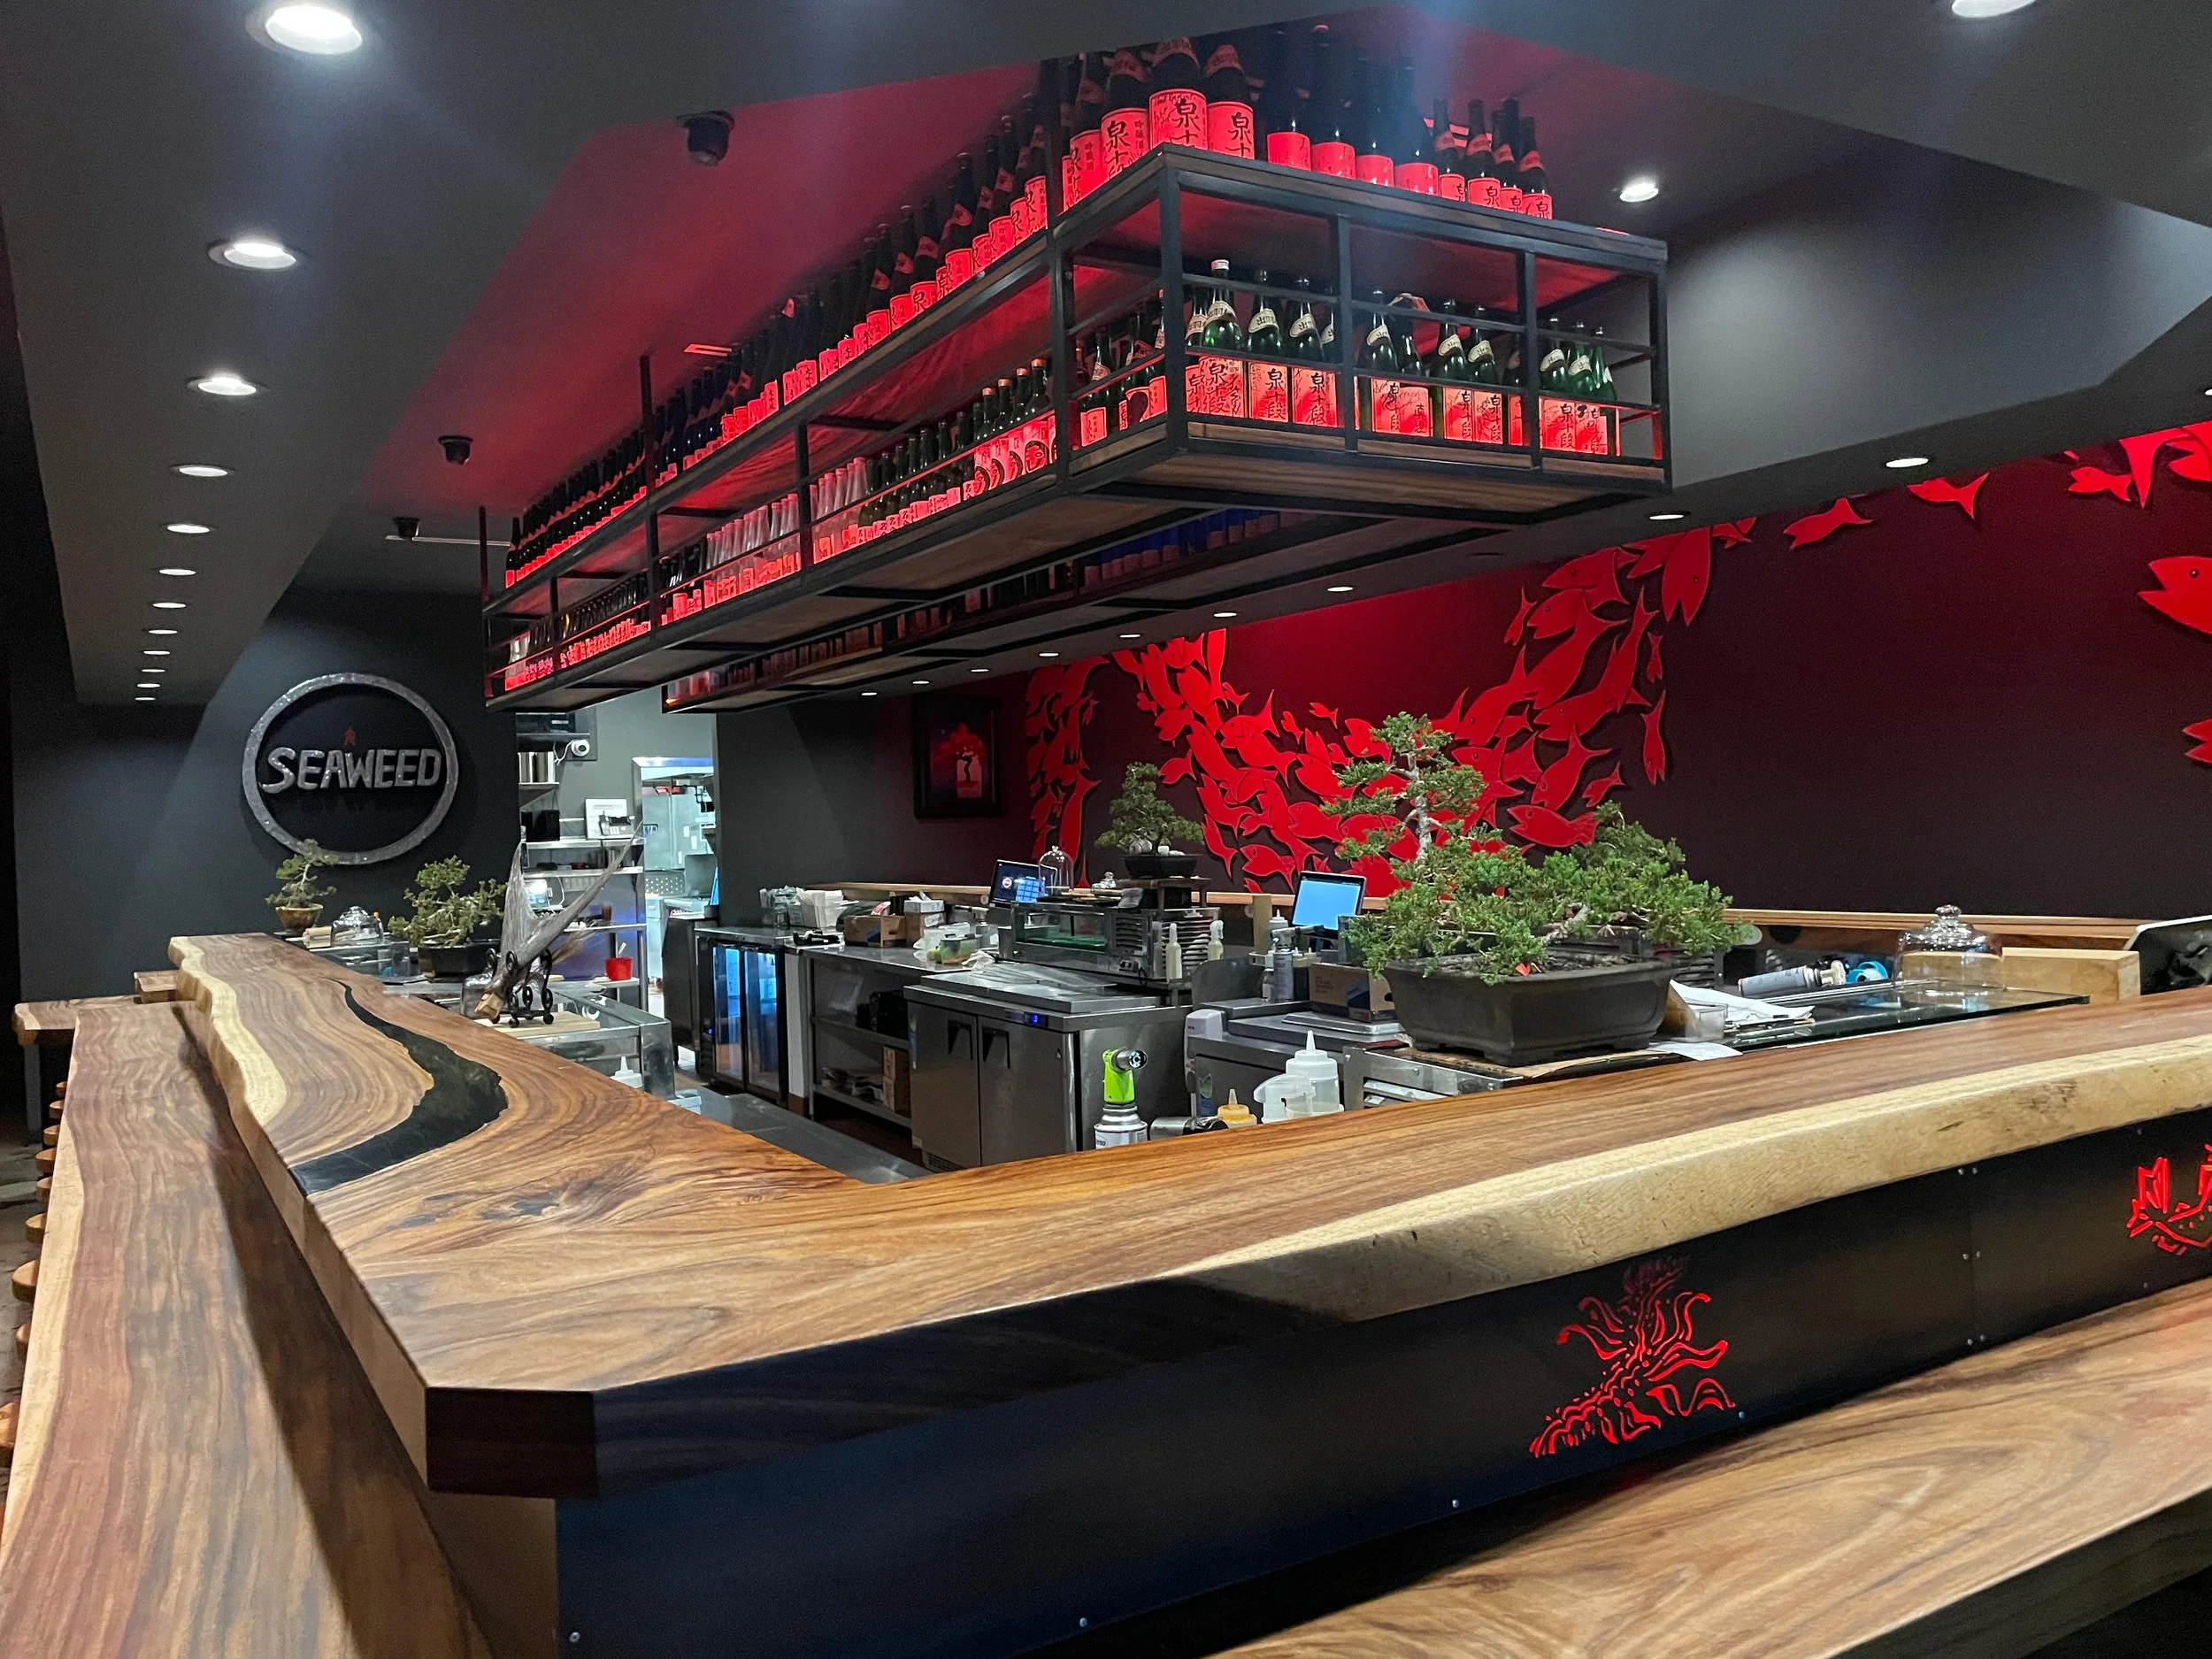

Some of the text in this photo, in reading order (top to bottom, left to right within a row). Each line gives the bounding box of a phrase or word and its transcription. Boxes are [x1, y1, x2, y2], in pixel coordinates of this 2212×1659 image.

[1266, 368, 1286, 420] 泉十段
[1309, 373, 1327, 425] 泉十段
[1558, 403, 1576, 449] 泉十段
[260, 747, 442, 794] SEAWEED
